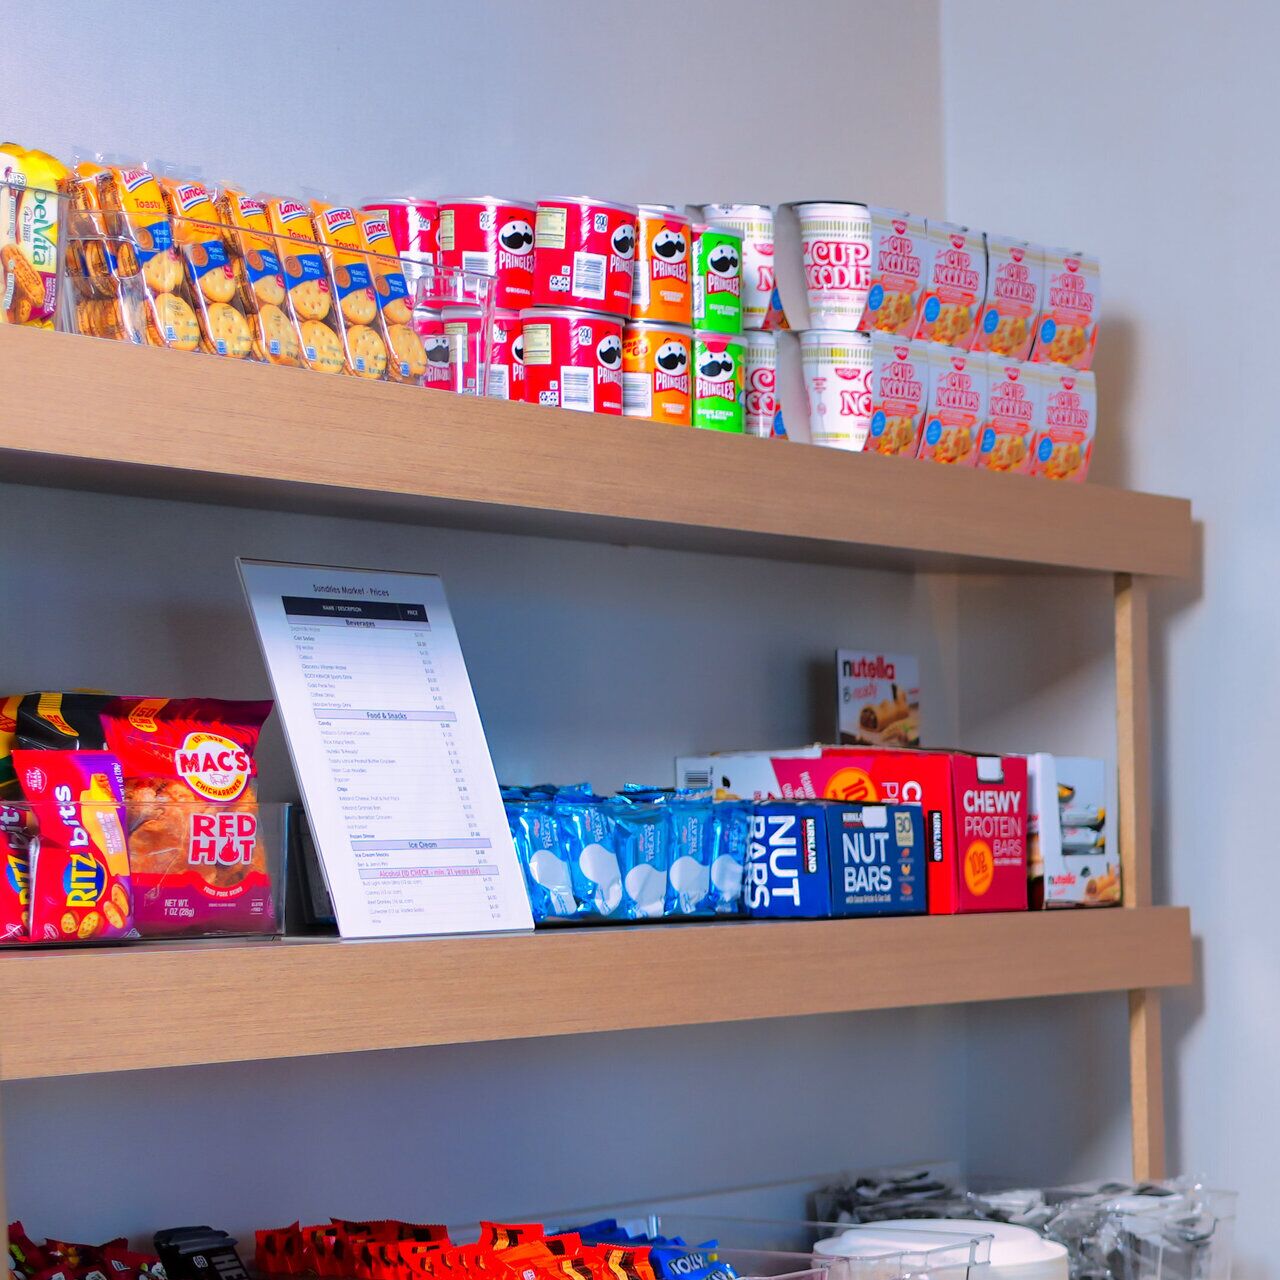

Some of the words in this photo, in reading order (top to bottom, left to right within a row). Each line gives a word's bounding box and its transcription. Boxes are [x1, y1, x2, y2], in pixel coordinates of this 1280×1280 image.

[326, 211, 352, 225] Lance
[365, 222, 388, 238] Lance
[812, 241, 869, 266] CUP
[652, 260, 687, 282] PRINGLES
[707, 272, 740, 296] PRINGLES
[696, 379, 735, 401] PRINGLES
[843, 656, 895, 681] nutella
[179, 751, 249, 774] MAC'S
[963, 791, 1020, 814] CHEWY
[54, 785, 88, 847] bits
[193, 814, 256, 837] RED
[964, 816, 1022, 838] PROTEIN
[191, 834, 255, 864] HOT
[842, 832, 889, 863] NUT
[992, 839, 1022, 857] BARS
[67, 853, 97, 908] RITZ
[844, 866, 892, 893] BARS
